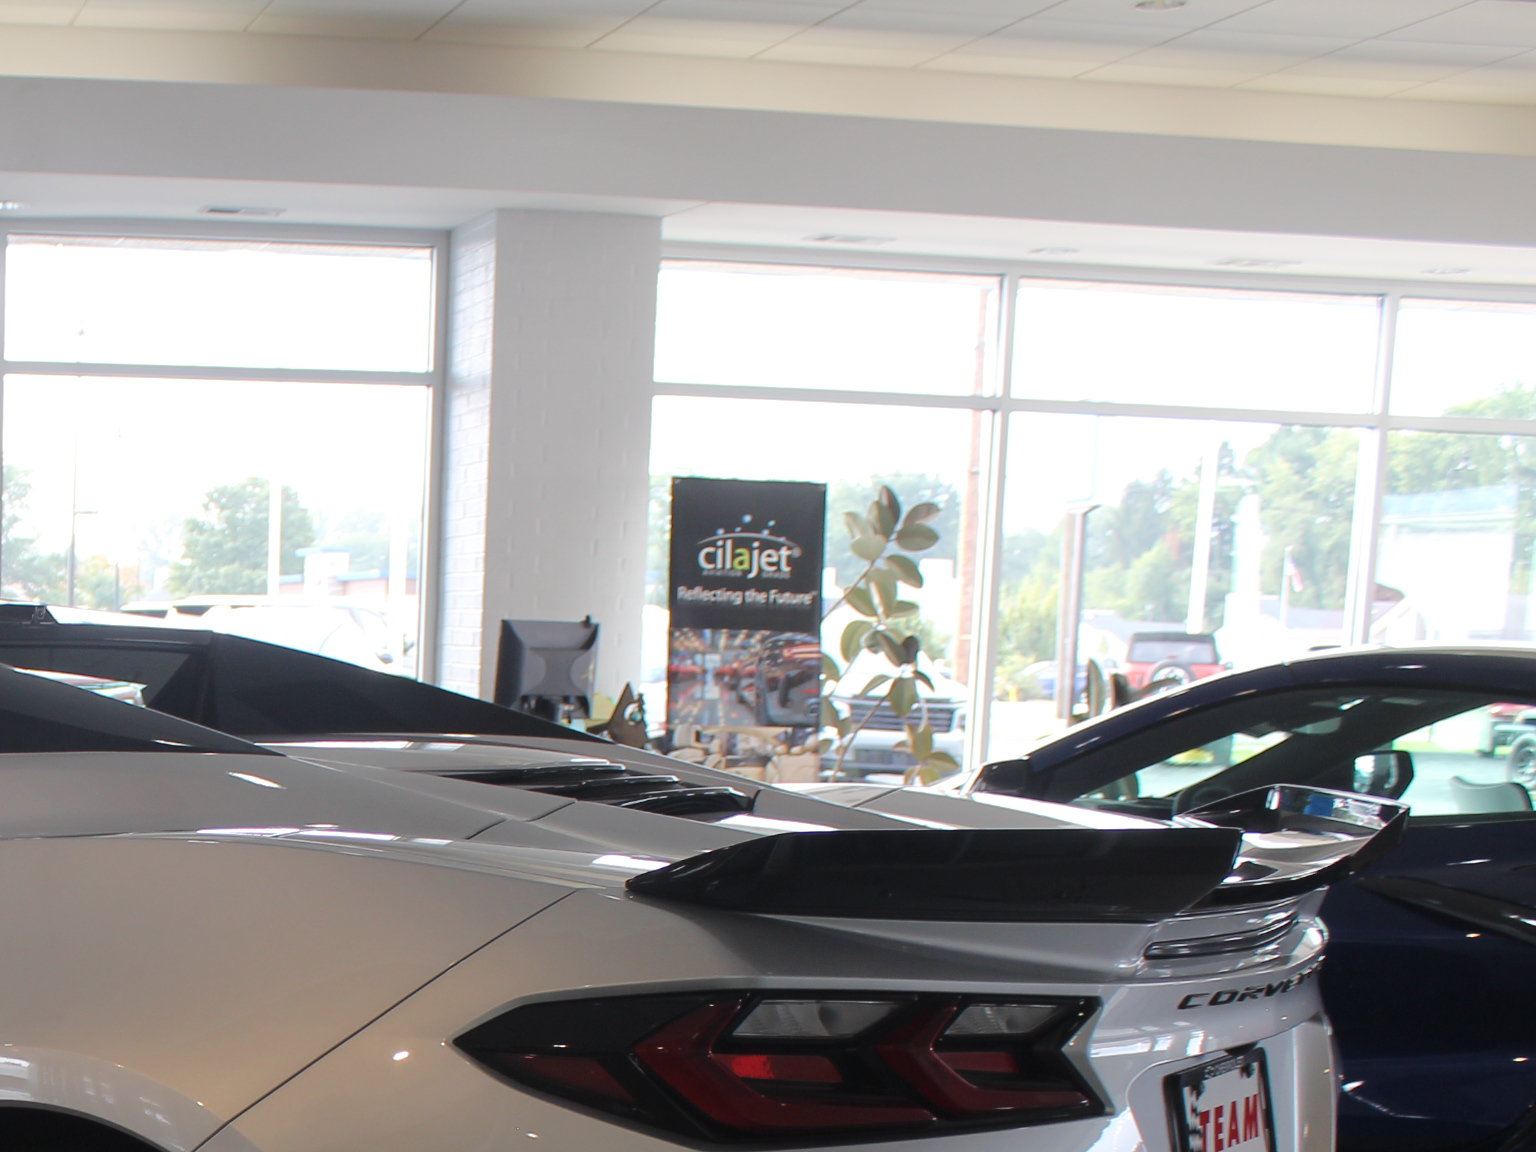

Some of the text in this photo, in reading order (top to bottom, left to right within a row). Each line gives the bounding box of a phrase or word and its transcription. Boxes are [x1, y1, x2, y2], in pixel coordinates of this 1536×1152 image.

[698, 539, 792, 579] cilajet
[677, 586, 743, 606] Reflecting
[744, 588, 767, 604] the
